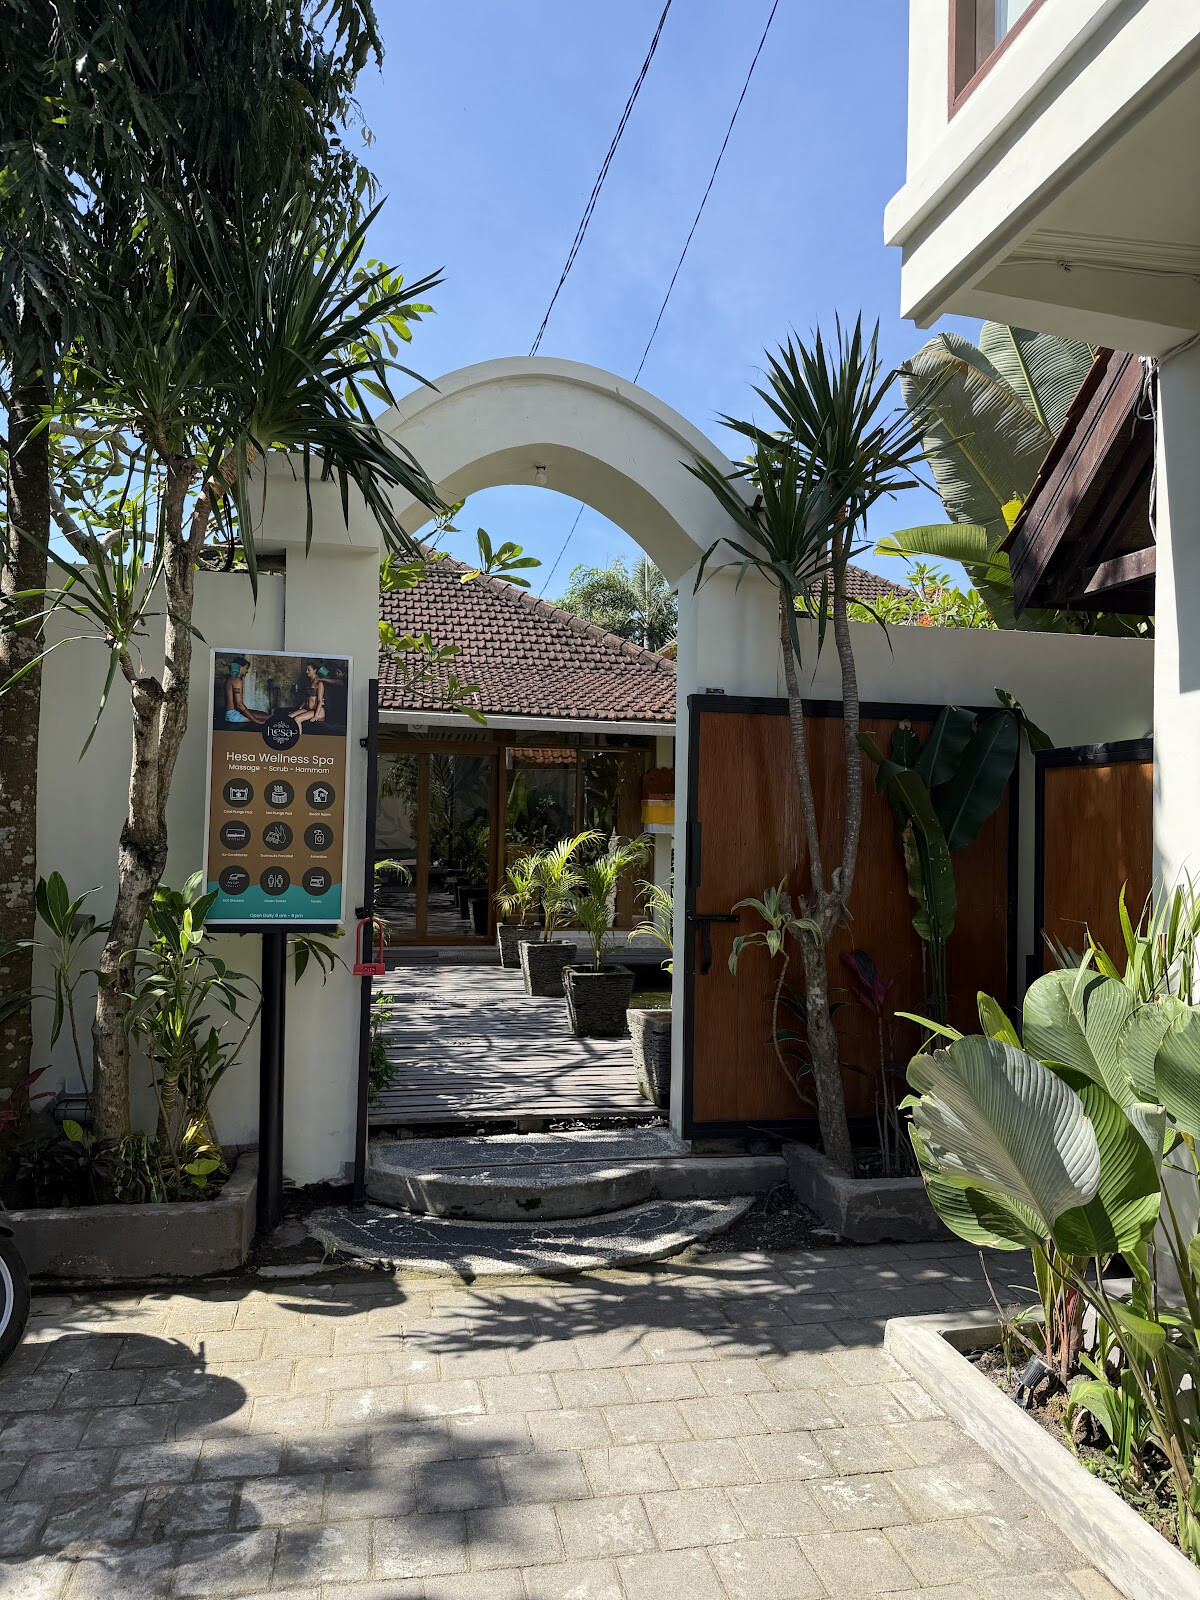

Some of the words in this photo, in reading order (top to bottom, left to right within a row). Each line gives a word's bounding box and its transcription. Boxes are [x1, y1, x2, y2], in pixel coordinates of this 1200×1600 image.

[268, 726, 298, 737] hesa
[226, 752, 256, 762] Hesa
[259, 753, 309, 764] Wellness
[312, 755, 334, 767] Spa
[228, 764, 260, 772] Massage
